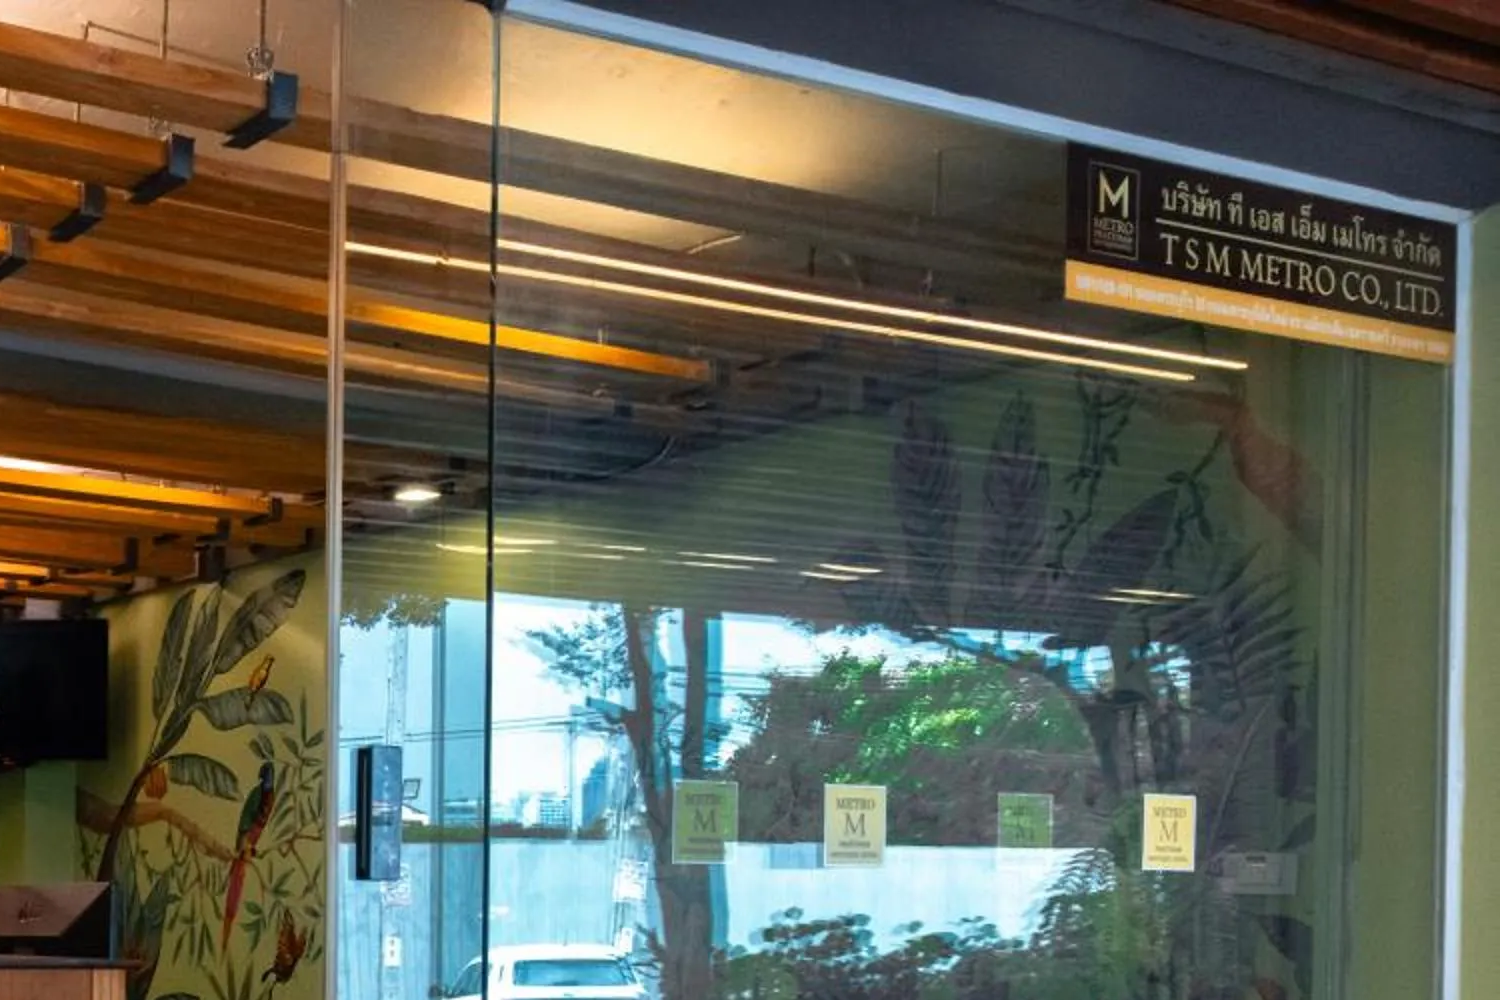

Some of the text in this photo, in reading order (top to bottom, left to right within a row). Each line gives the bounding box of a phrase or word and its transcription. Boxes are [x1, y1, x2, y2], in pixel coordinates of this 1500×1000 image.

[1099, 169, 1129, 219] M
[1161, 181, 1442, 268] บริษัท ที เอส เอ็ม เมโทร จำกัด
[1240, 249, 1336, 296] METRO
[1342, 271, 1389, 310] CO.,
[1395, 281, 1444, 317] LTD.
[836, 797, 876, 811] METRO
[694, 808, 716, 833] M
[844, 812, 866, 836] M
[1159, 820, 1178, 843] M
